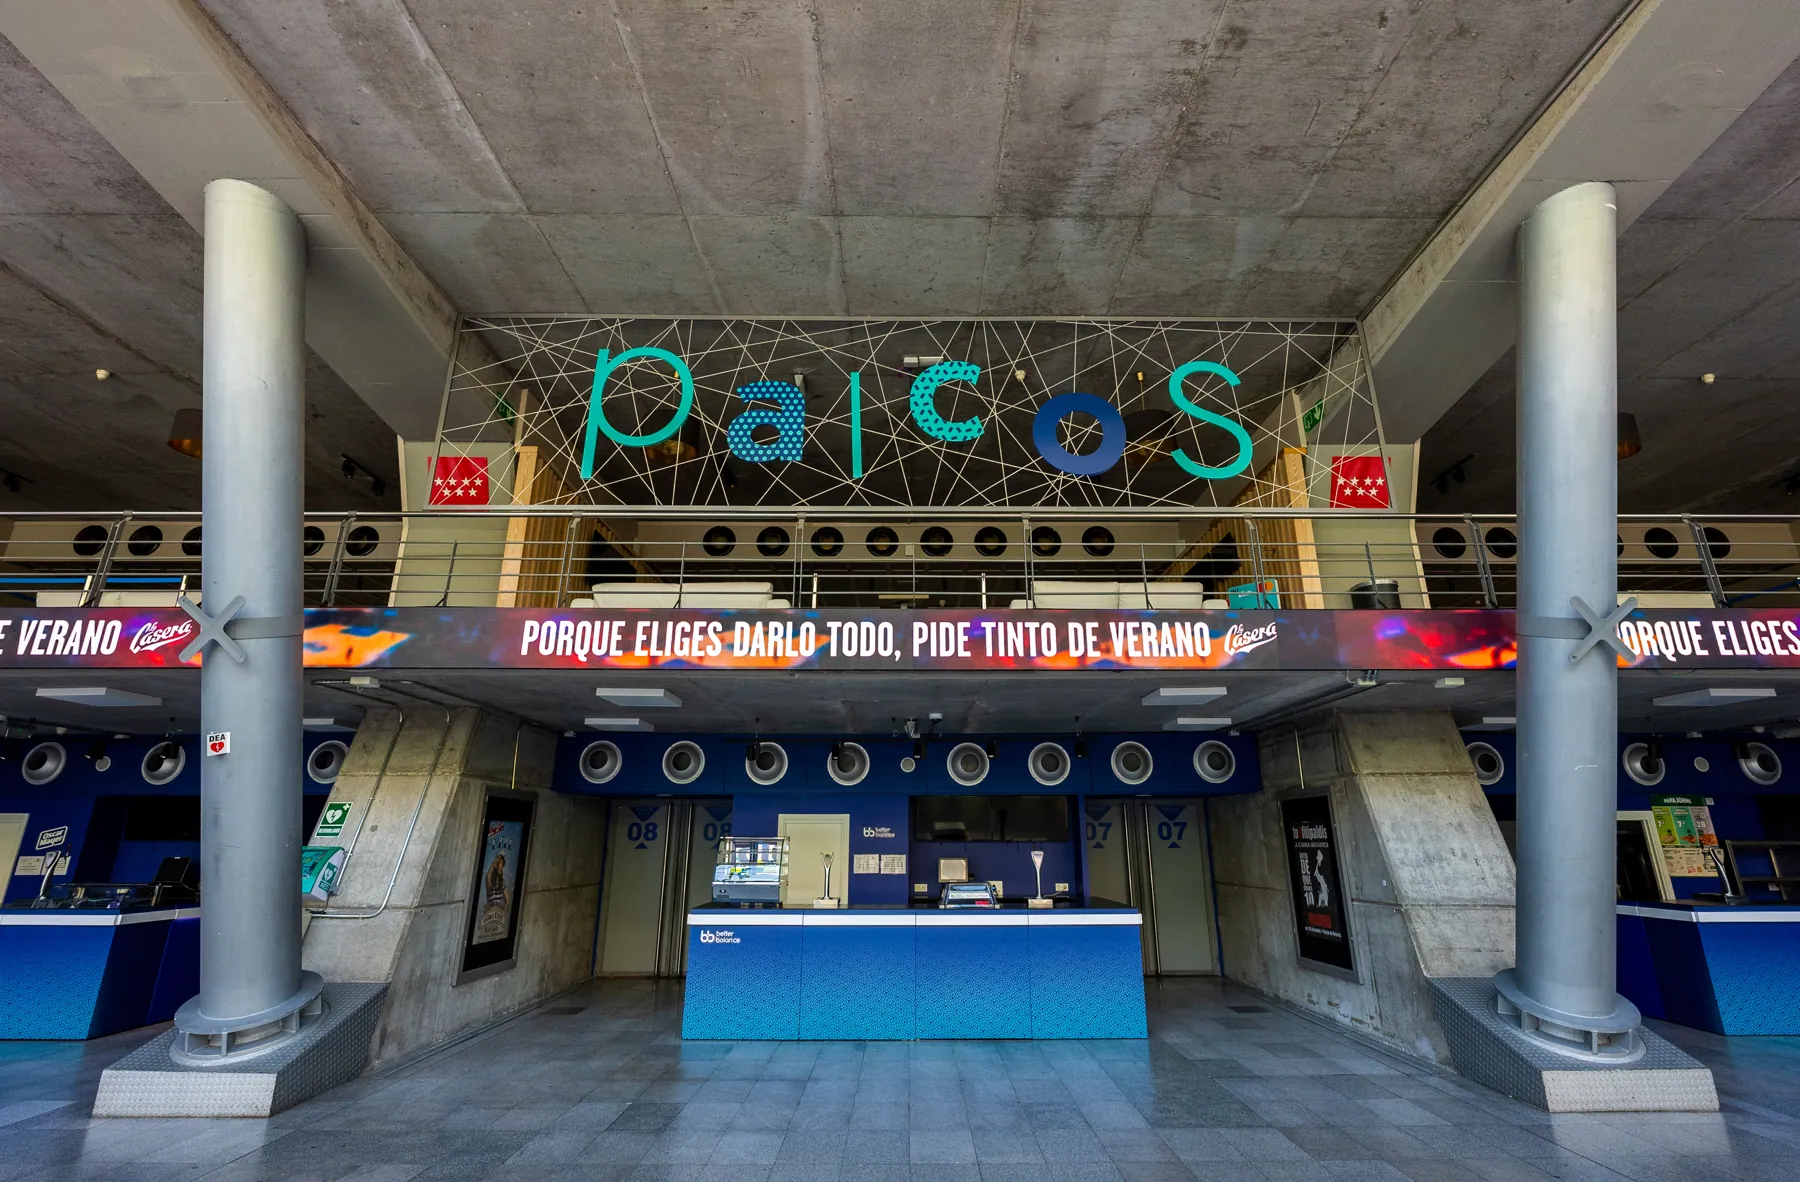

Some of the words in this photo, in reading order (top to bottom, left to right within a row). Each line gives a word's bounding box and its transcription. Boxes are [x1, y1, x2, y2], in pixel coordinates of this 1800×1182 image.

[17, 620, 121, 655] VERANO
[130, 620, 192, 654] Casera
[521, 620, 625, 661] PORQUE
[634, 621, 723, 657] ELIGES
[733, 621, 815, 657] DARLO
[827, 622, 901, 661] TODO,
[913, 622, 971, 657] PIDE
[981, 622, 1057, 657] TINTO
[1068, 622, 1099, 657] DE
[1109, 622, 1211, 657] VERANO
[1224, 622, 1277, 656] Casera
[1617, 621, 1710, 662] ORQUE
[1712, 621, 1800, 655] ELIGES
[209, 734, 226, 742] DEA
[42, 829, 65, 840] Oscar
[627, 822, 659, 841] 08
[863, 826, 875, 837] bb
[1085, 822, 1113, 840] 07
[1157, 821, 1188, 841] 07
[39, 836, 64, 846] Mayer
[700, 930, 715, 943] bb
